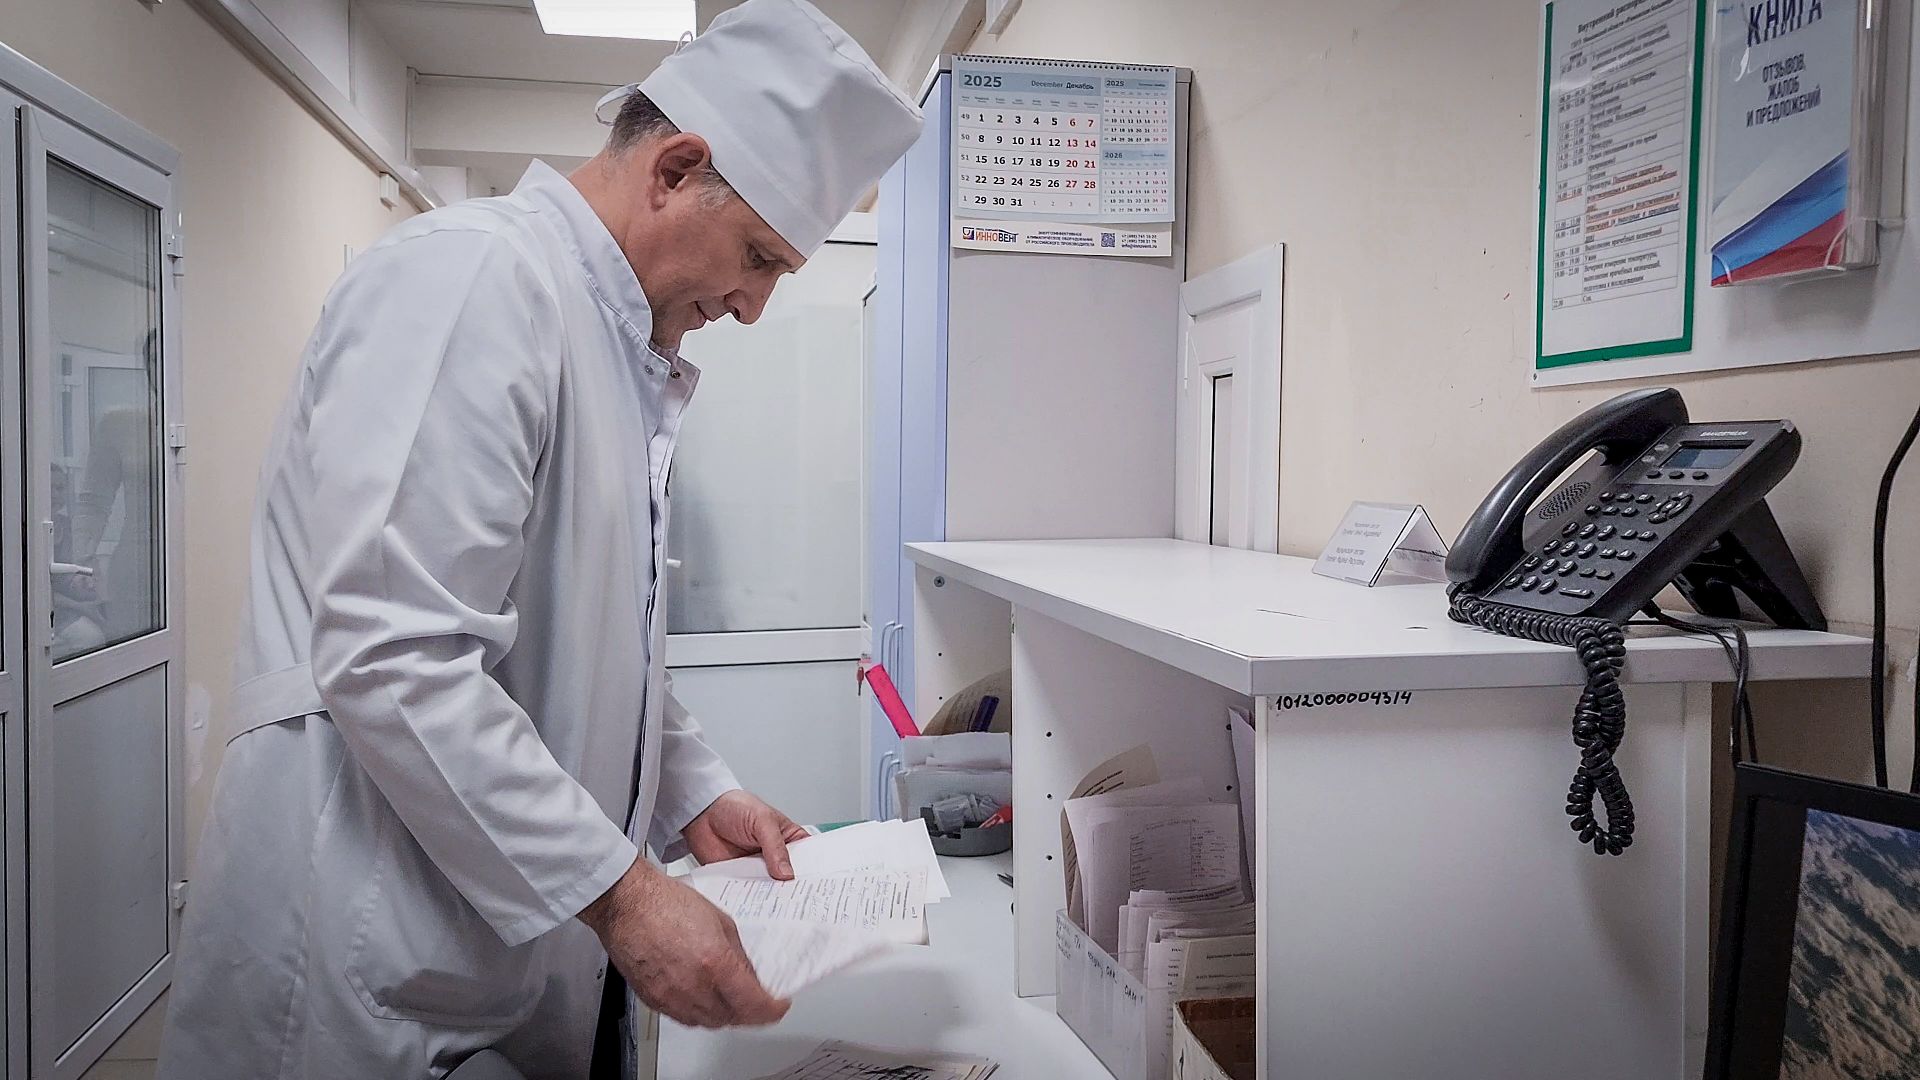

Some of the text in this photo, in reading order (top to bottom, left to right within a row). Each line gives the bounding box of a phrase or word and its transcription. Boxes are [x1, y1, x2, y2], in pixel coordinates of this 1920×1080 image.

[1748, 0, 1822, 47] КНИГА
[964, 74, 1094, 90] 2025 December Декабрь
[1768, 76, 1800, 101] ЖАЛОБ
[1746, 84, 1822, 128] И ПРЕДЛОЖЕНИЙ
[979, 114, 984, 122] 1
[997, 115, 1003, 123] 2
[1015, 116, 1021, 124] 3
[1052, 117, 1057, 126] 5
[1070, 118, 1076, 126] 6
[1068, 139, 1078, 147] 13
[976, 155, 987, 163] 15
[1066, 160, 1078, 168] 20
[1084, 160, 1095, 168] 21
[975, 175, 987, 183] 22
[1011, 178, 1023, 186] 24
[975, 196, 986, 204] 29
[993, 197, 1005, 205] 30
[976, 231, 1018, 242] ИННОВЕНТ
